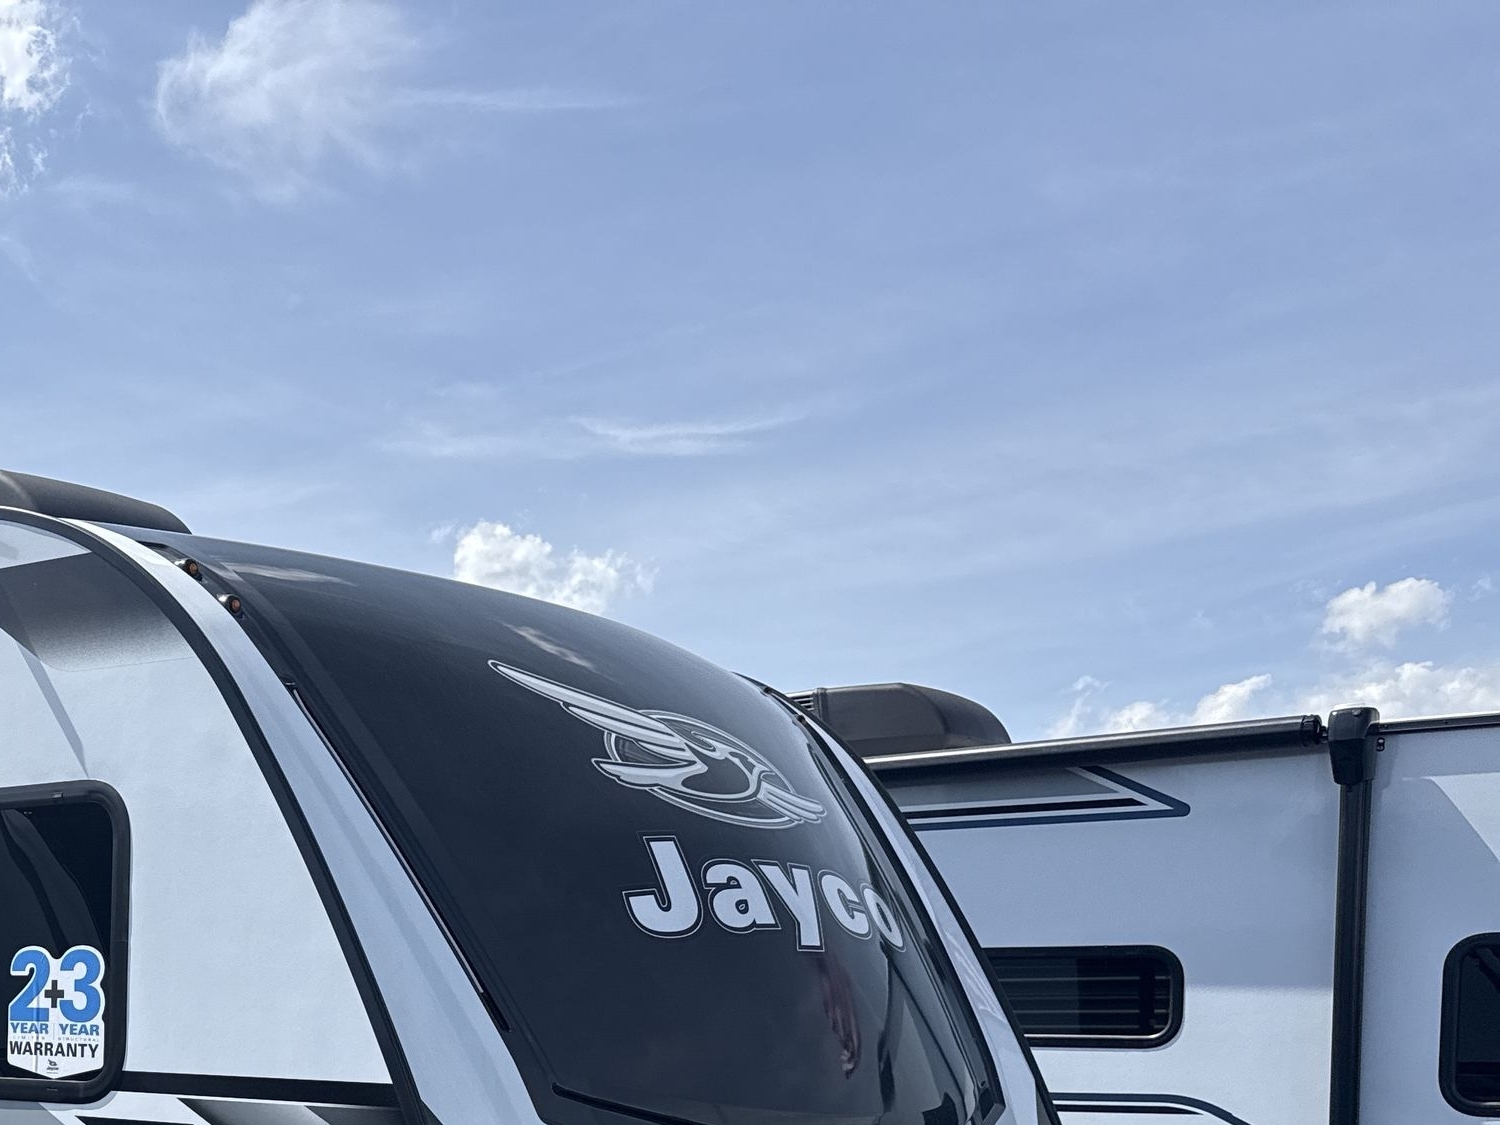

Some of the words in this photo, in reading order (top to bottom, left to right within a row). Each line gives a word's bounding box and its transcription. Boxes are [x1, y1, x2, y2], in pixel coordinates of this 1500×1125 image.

[622, 836, 905, 952] Jayco
[10, 1022, 49, 1034] YEAR
[59, 1023, 100, 1036] YEAR
[9, 1040, 99, 1058] WARRANTY
